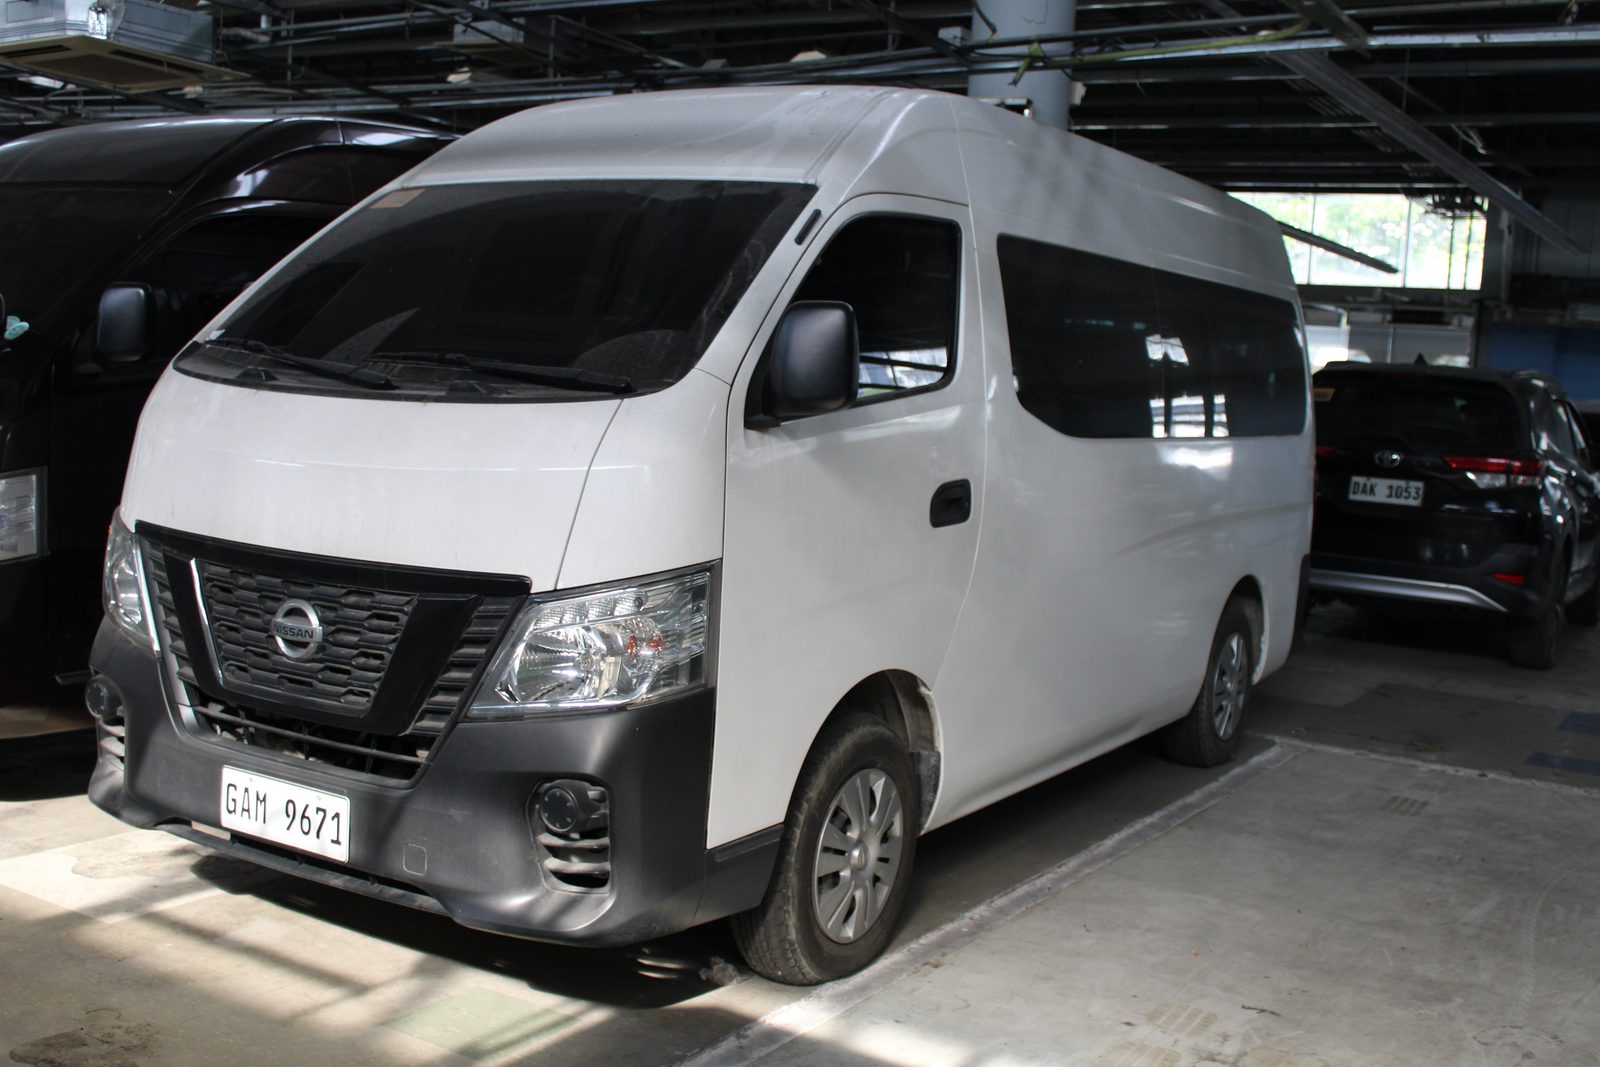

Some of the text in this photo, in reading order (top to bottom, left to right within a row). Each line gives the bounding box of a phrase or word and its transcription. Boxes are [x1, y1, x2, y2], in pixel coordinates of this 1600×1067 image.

[1352, 481, 1421, 501] DAK 1053
[274, 623, 314, 639] NISSAN
[226, 783, 342, 846] GAM 9671
